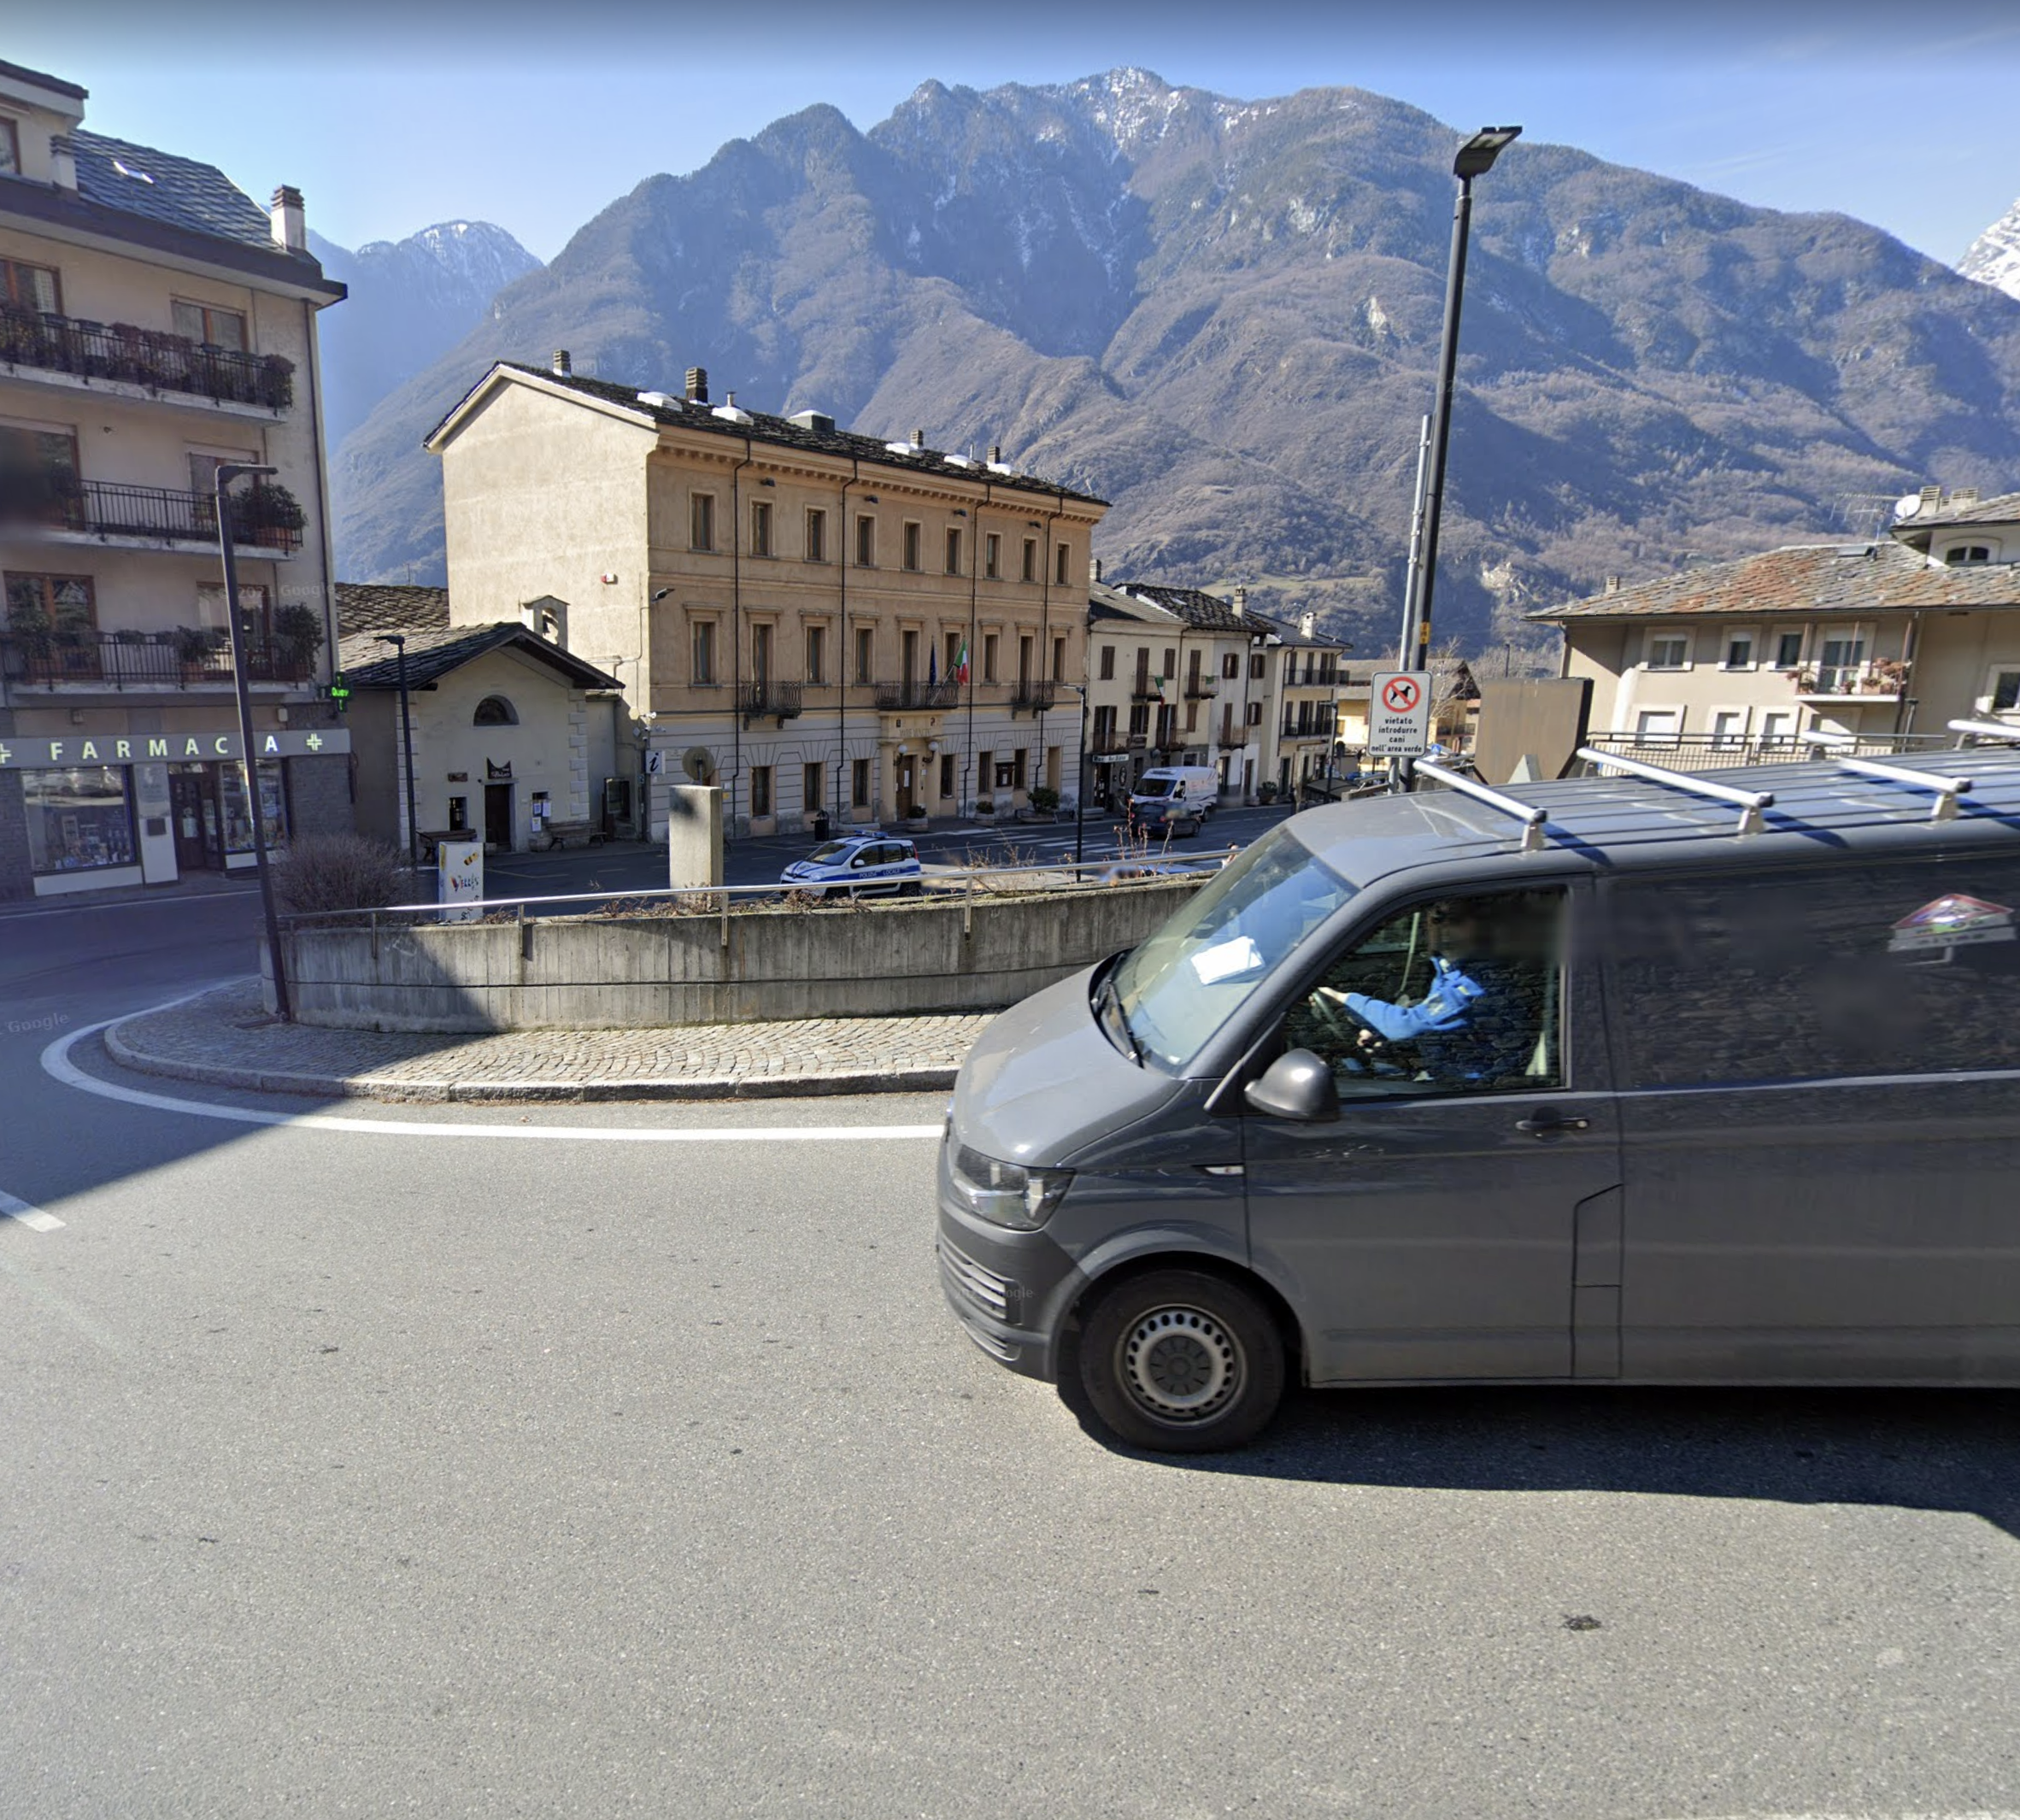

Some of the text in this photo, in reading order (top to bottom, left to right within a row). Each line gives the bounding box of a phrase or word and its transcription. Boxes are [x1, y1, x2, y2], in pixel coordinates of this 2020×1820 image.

[1384, 716, 1413, 725] vietato
[1377, 725, 1418, 734] introdurre
[1389, 735, 1406, 743] cani
[50, 735, 279, 761] FARMACA
[1403, 744, 1423, 753] verde
[859, 867, 901, 879] POLIZIA LOCALE
